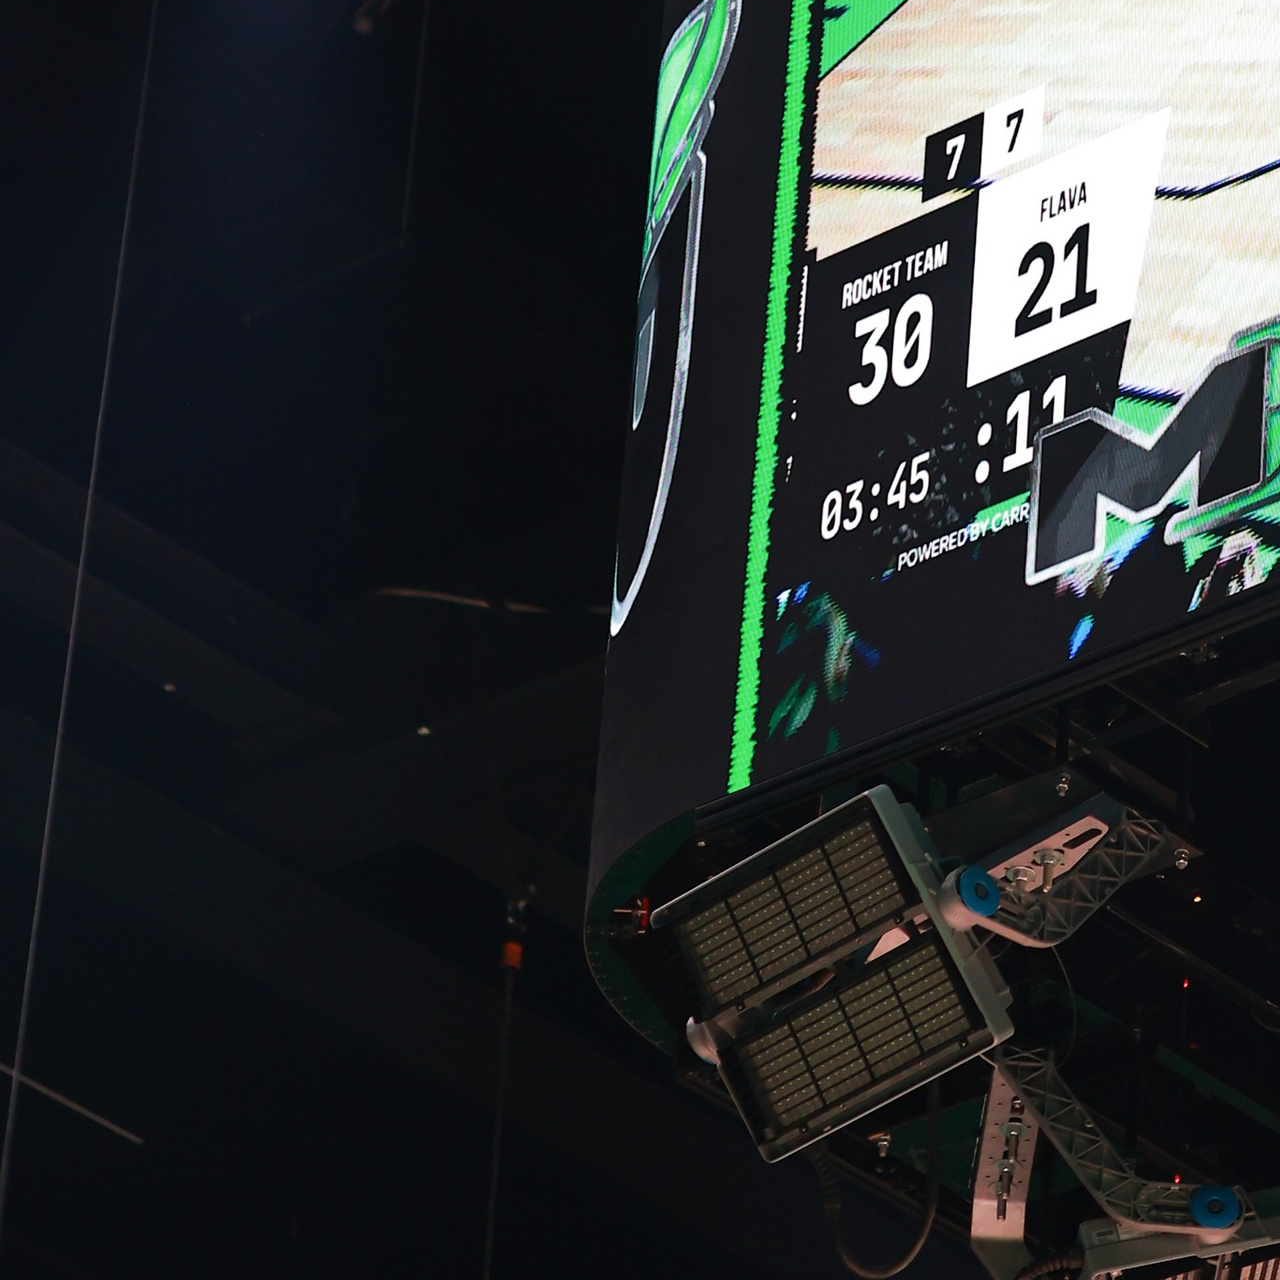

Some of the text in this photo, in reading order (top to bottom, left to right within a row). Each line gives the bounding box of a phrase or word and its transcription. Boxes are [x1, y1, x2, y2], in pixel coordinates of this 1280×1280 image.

[946, 108, 1025, 181] 7 7
[1039, 181, 1088, 223] FLAVA
[841, 239, 949, 310] ROCKET TEAM
[1014, 222, 1099, 338] 21
[848, 292, 934, 406] 30
[820, 451, 931, 541] 03:45
[897, 502, 1030, 572] POWERED BY CARR
